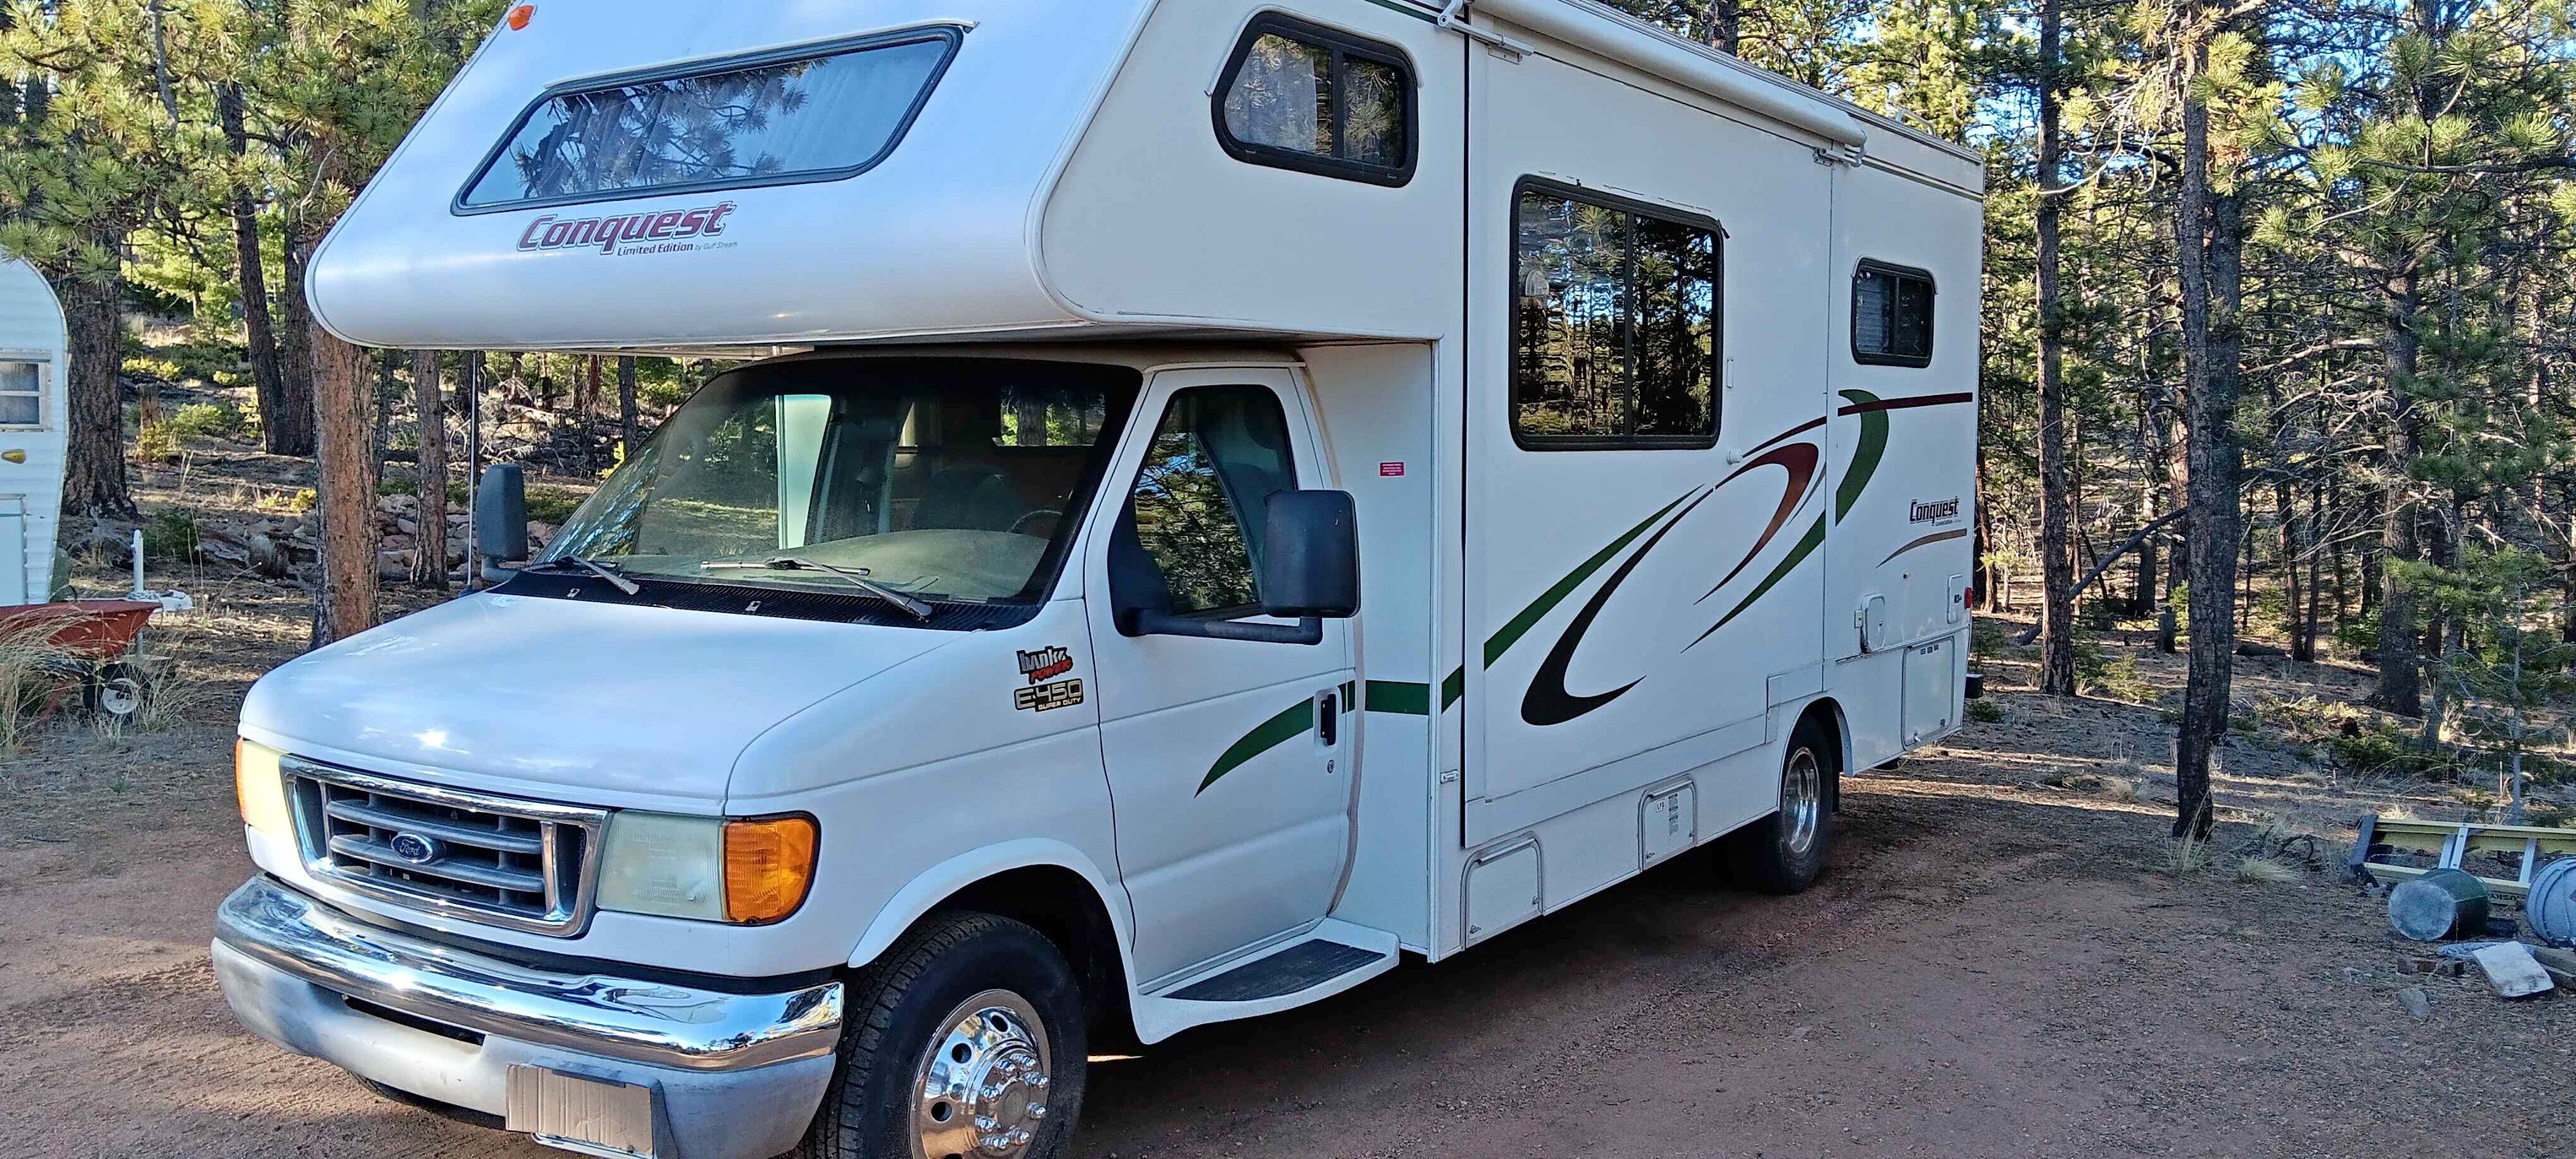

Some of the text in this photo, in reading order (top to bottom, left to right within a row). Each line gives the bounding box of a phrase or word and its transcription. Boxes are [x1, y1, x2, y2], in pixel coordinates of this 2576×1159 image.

[517, 201, 737, 255] Conquest
[617, 244, 655, 256] Limited
[658, 241, 693, 253] Edition
[1909, 496, 1960, 526] Conquest
[1038, 696, 1082, 711] SUPER DUTY
[399, 838, 420, 856] Ford
